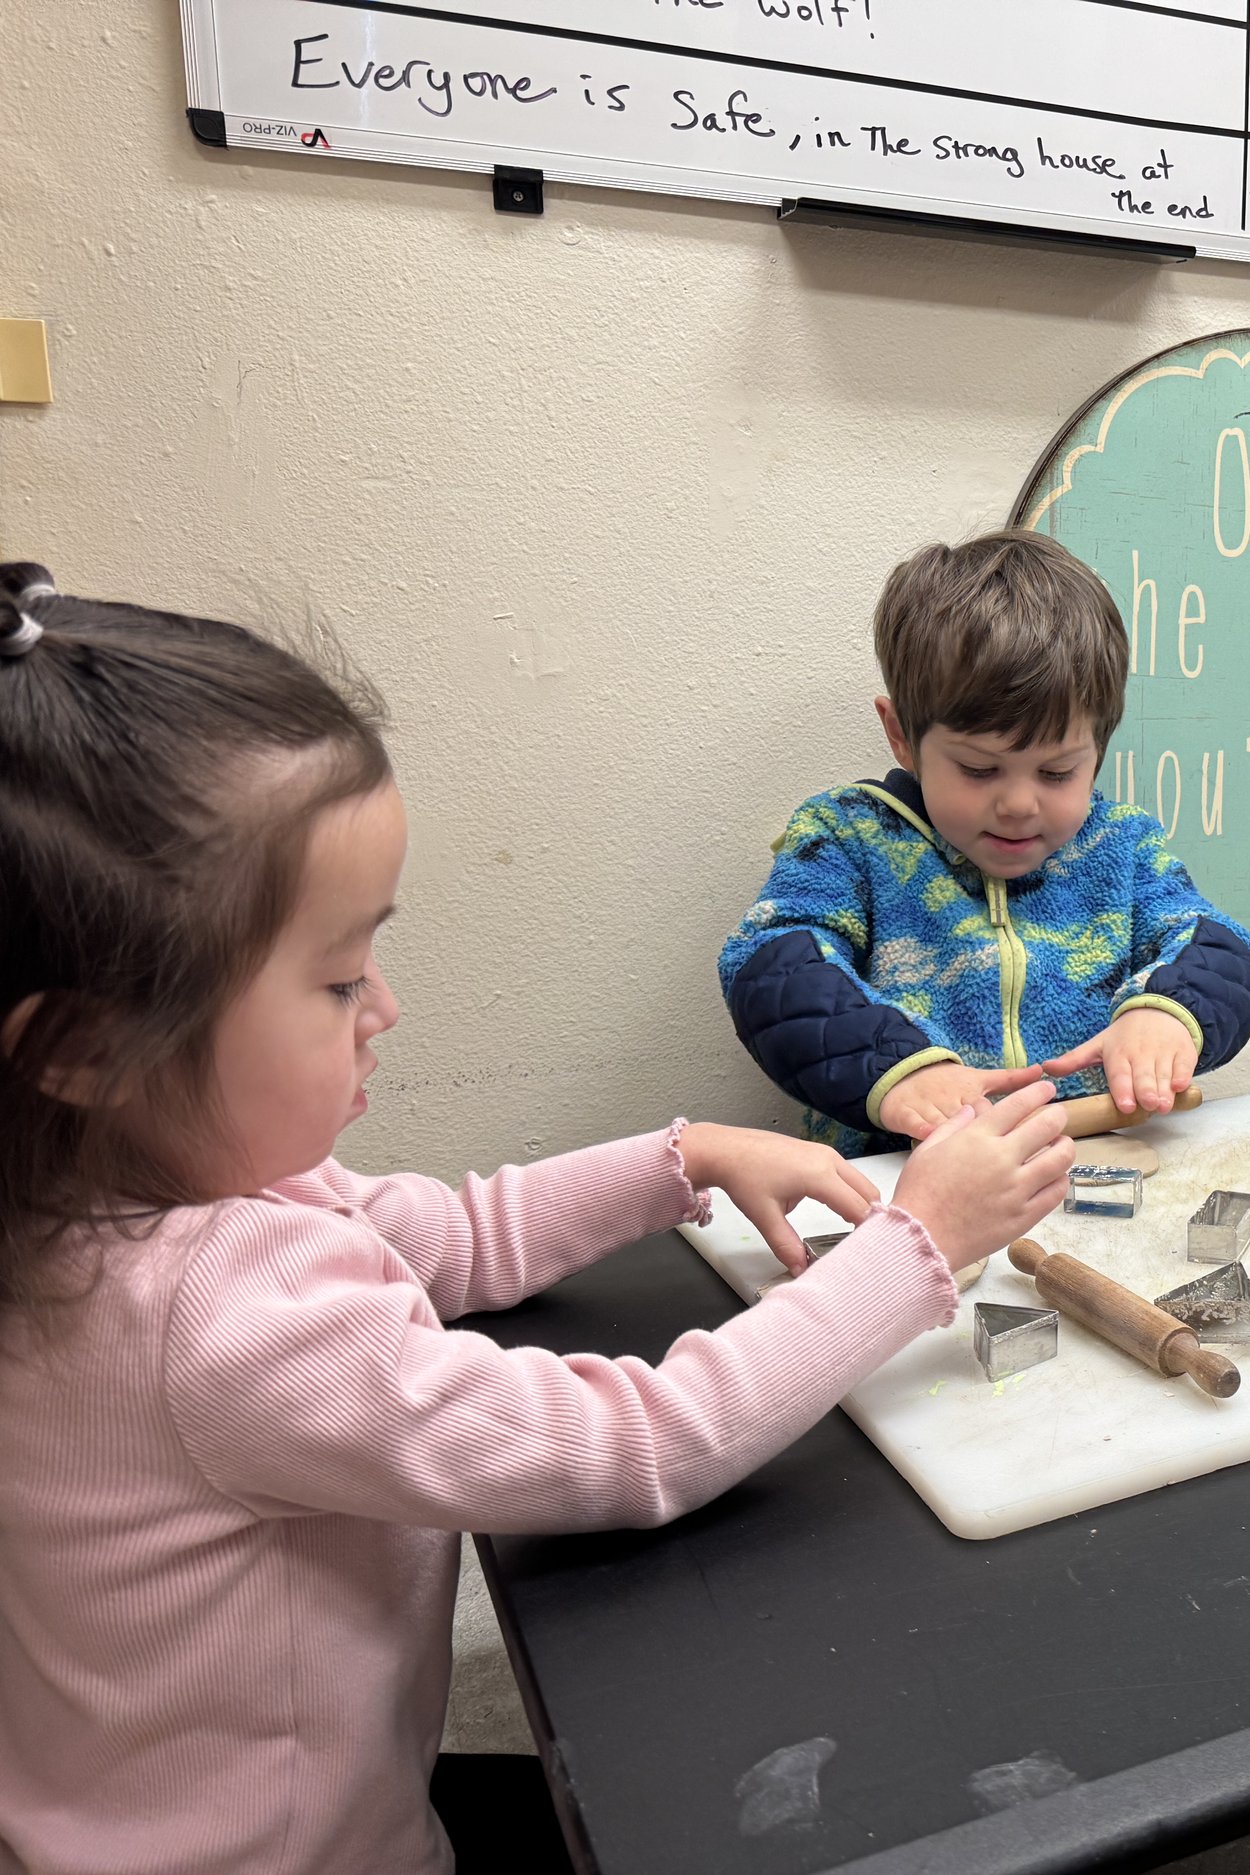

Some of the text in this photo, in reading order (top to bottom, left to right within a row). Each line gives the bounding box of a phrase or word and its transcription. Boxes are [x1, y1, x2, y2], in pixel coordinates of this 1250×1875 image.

[242, 122, 297, 137] VIZ-PRO
[291, 33, 558, 117] Everyone
[579, 75, 630, 112] is
[814, 116, 852, 148] in
[1036, 137, 1126, 180] house
[1141, 149, 1174, 180] at
[1167, 196, 1214, 219] end
[1131, 549, 1207, 679] he
